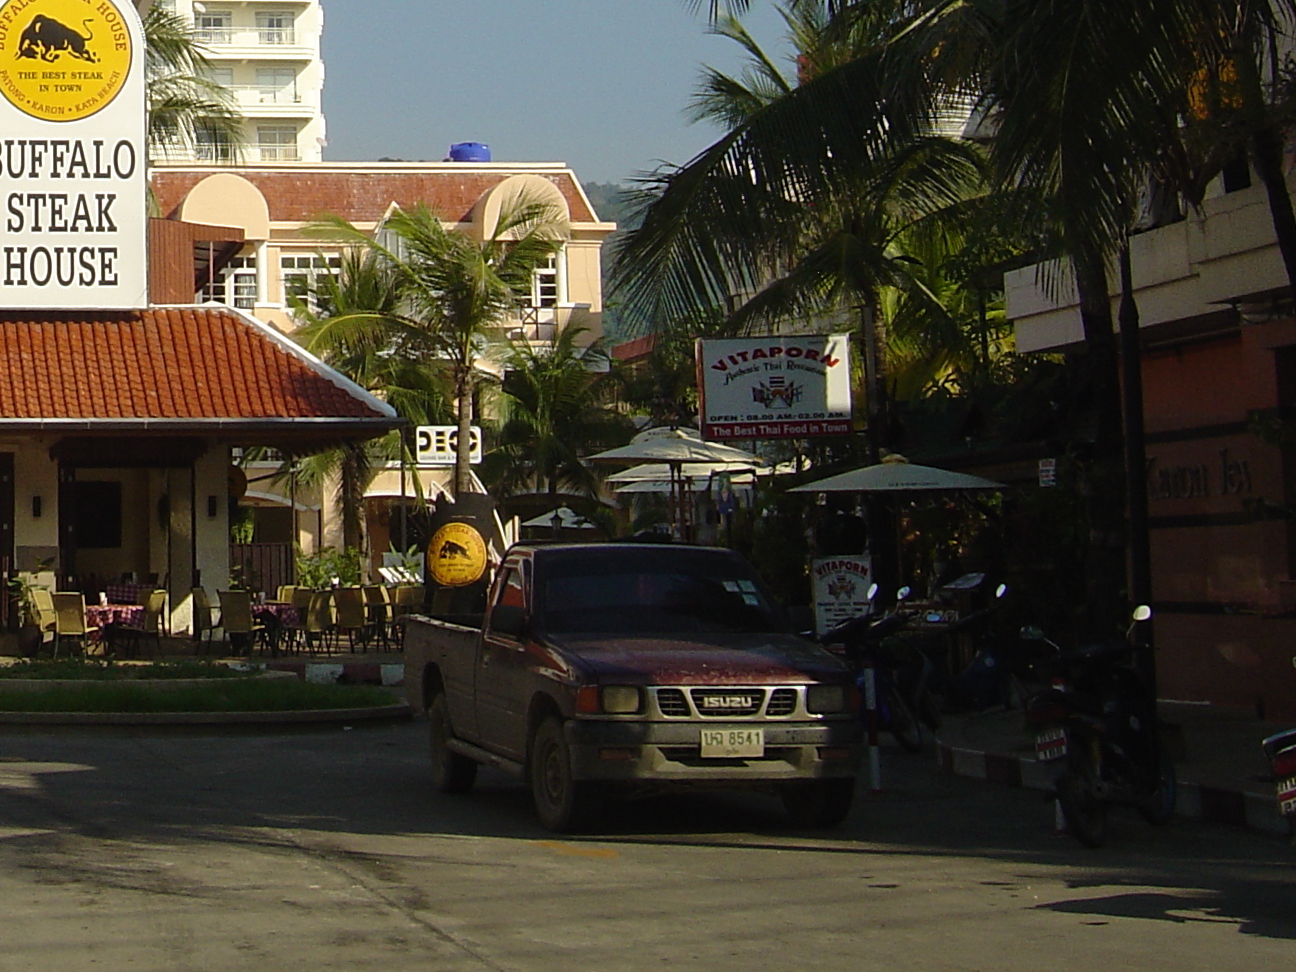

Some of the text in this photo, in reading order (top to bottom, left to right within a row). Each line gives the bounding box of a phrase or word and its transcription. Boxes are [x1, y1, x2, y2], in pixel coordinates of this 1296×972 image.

[96, 2, 127, 52] HOUSE
[17, 71, 104, 80] THE BEST STEAK
[0, 69, 121, 115] PATONG KARON KATA BEACH
[39, 84, 82, 92] IN TOWN
[7, 192, 118, 233] STEAK
[3, 246, 119, 287] HOUSE
[710, 345, 840, 372] VITAPORN
[709, 415, 738, 423] OPEN
[711, 423, 848, 437] The Best Thai Food in Town
[815, 560, 869, 577] VITAPORN
[704, 696, 753, 708] ISUZU
[728, 731, 760, 746] 8541
